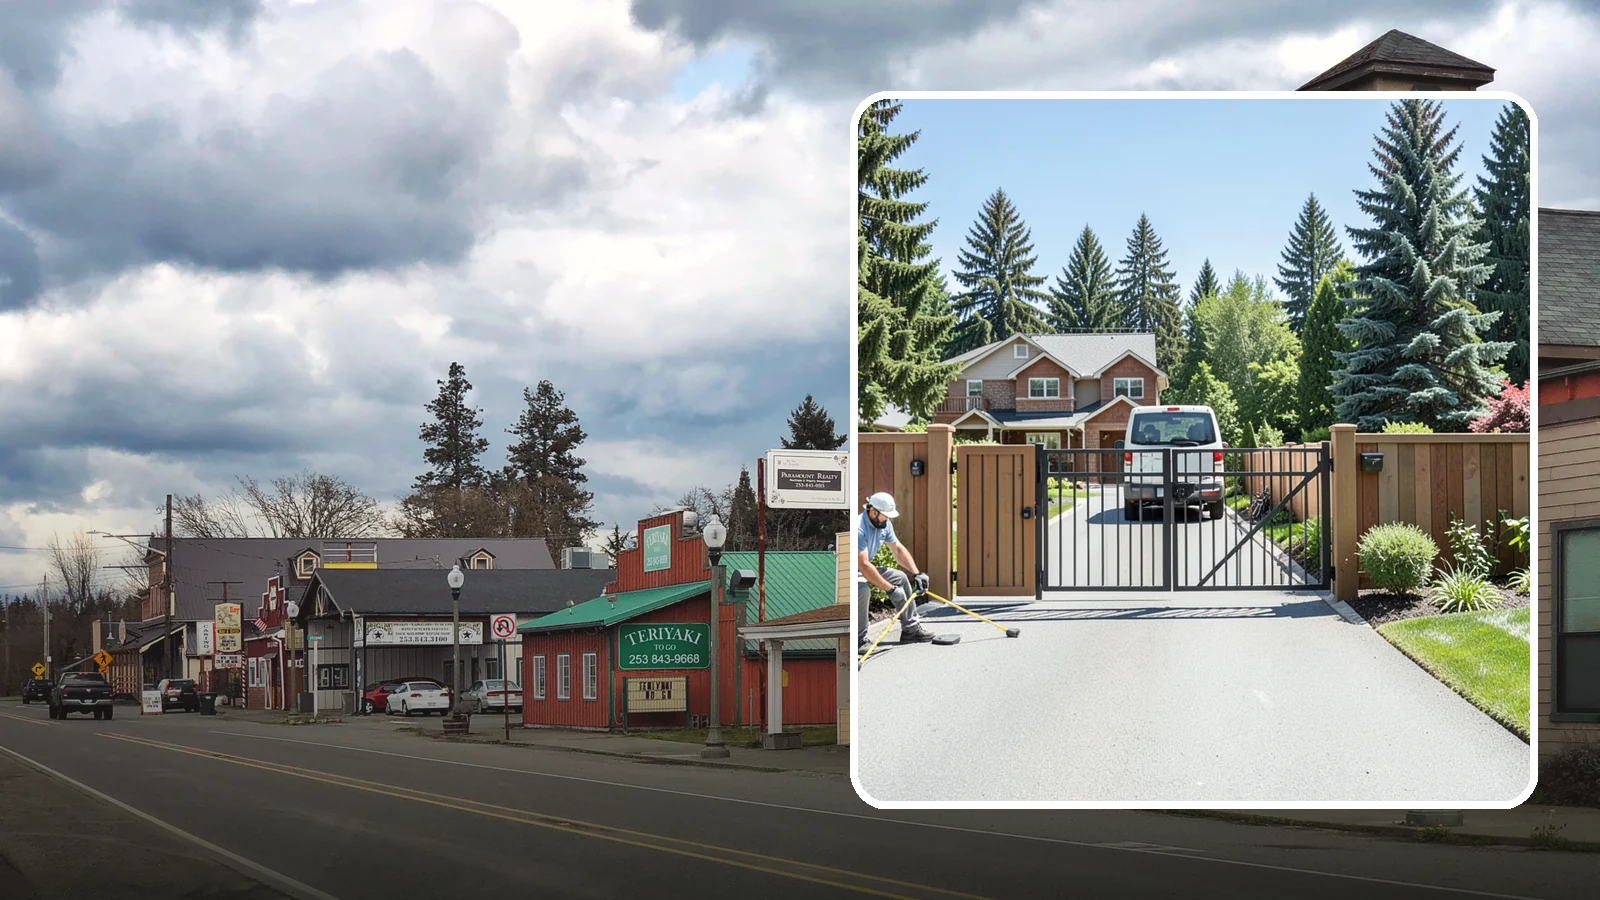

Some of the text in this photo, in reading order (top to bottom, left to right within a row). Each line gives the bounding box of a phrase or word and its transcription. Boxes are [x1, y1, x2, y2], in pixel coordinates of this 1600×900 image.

[625, 628, 702, 646] TERIYAKI
[628, 654, 700, 664] 253 843-9668
